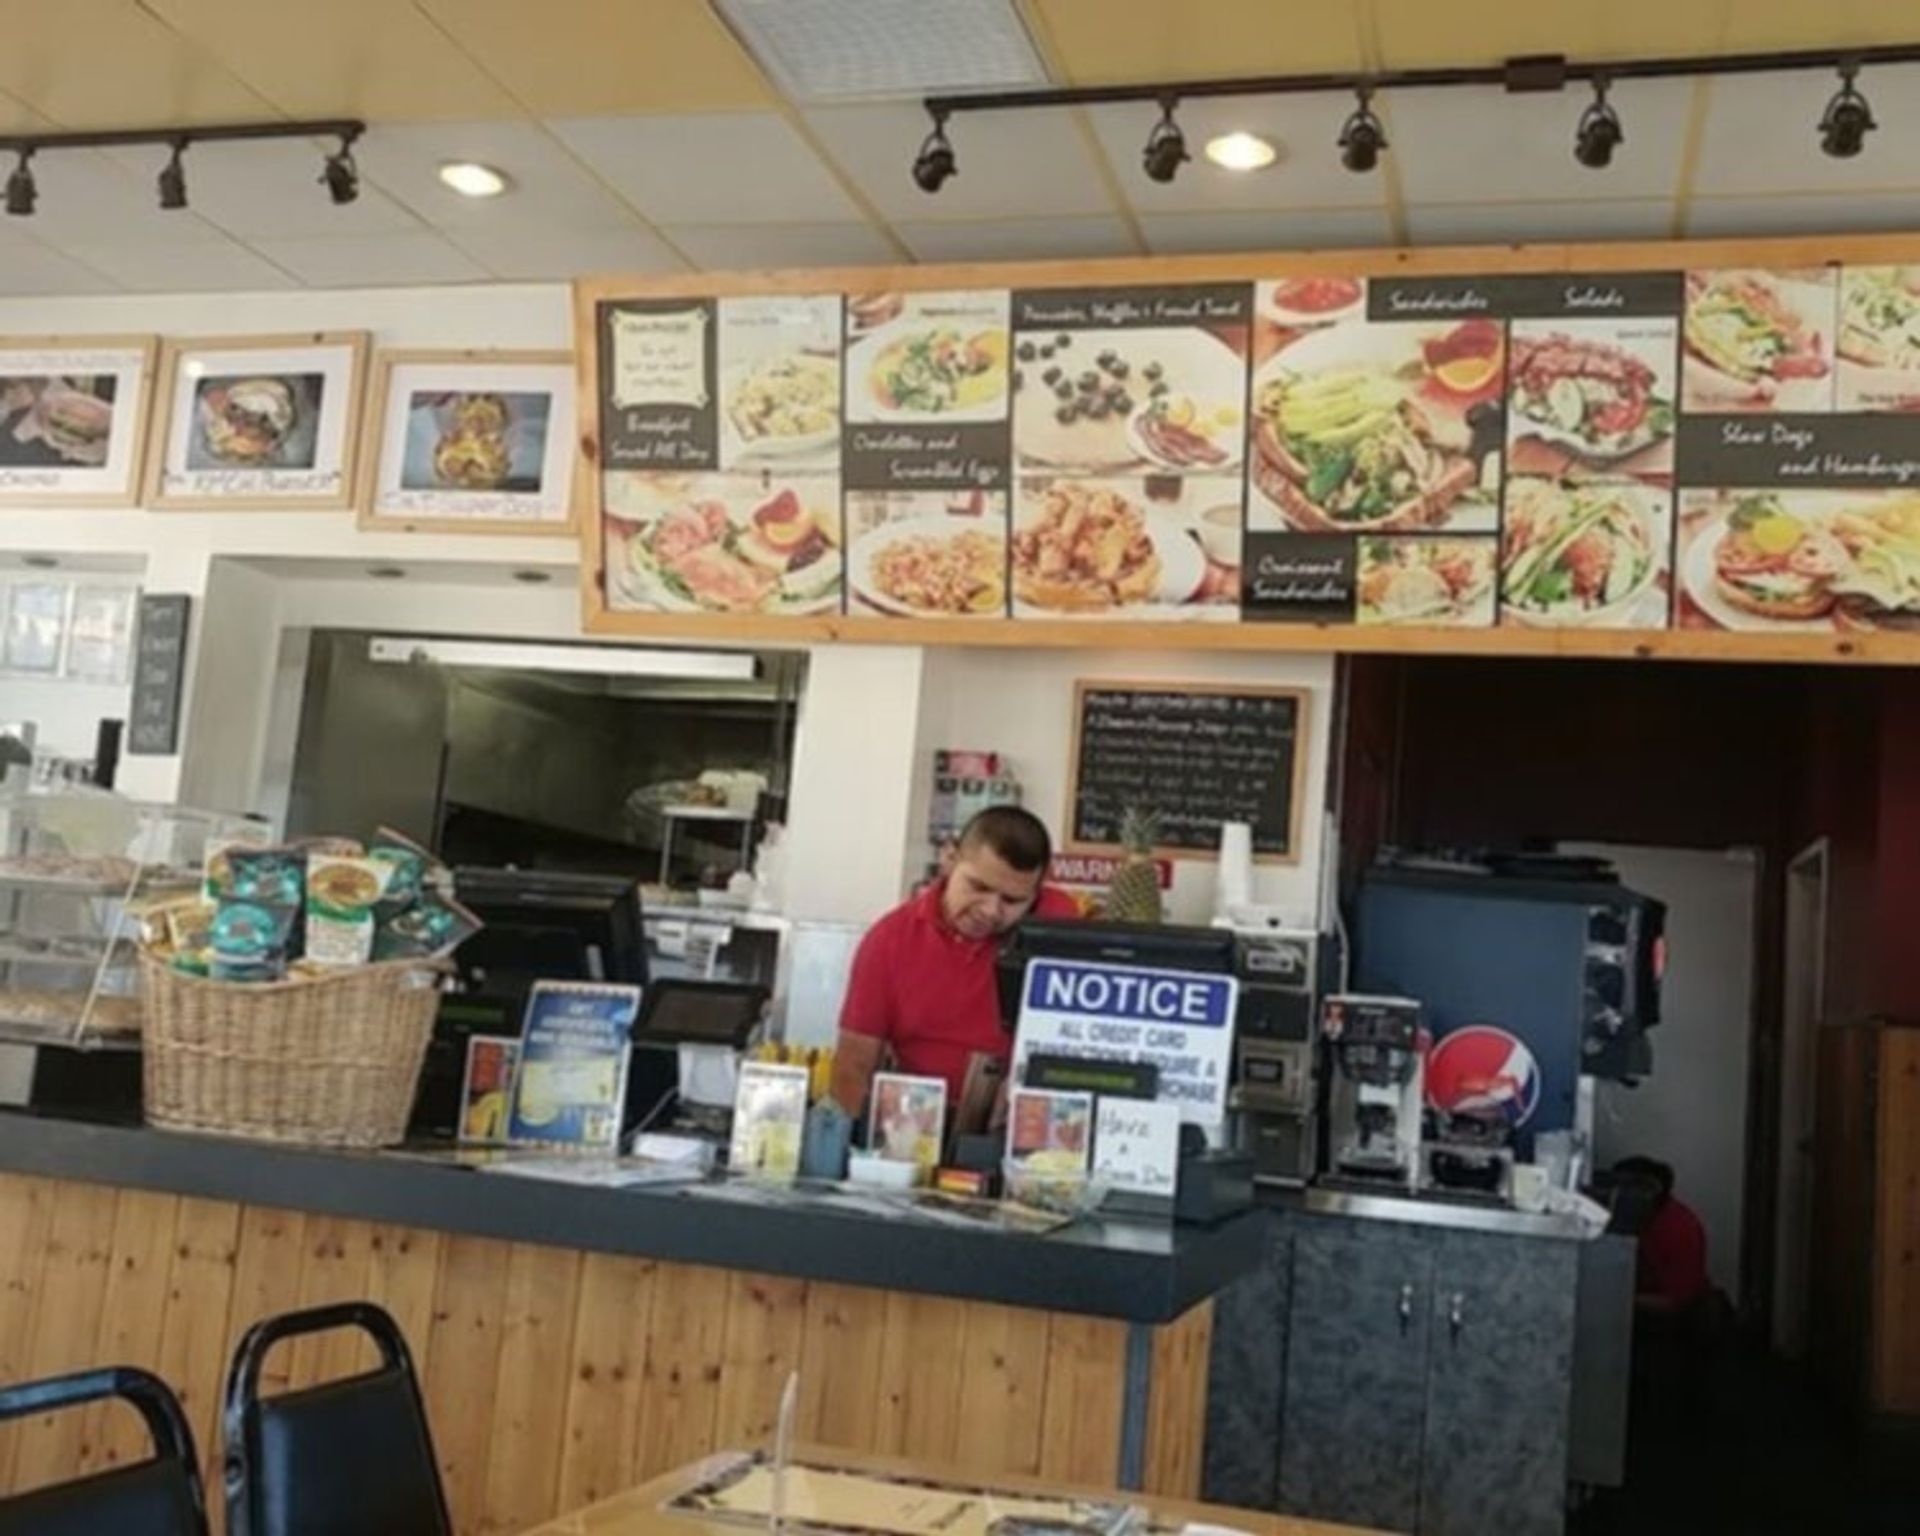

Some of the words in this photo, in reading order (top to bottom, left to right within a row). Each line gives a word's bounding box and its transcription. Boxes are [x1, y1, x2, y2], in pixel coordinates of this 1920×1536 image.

[1389, 291, 1488, 311] Sandwiches
[1563, 286, 1624, 308] Salads
[926, 432, 960, 449] and
[1771, 422, 1814, 451] Dogs
[1779, 454, 1818, 475] and
[1252, 579, 1348, 599] Sandwiches
[1045, 970, 1210, 1021] NOTICE
[1058, 1022, 1083, 1039] ALL
[1088, 1025, 1141, 1045] CREDIT
[1145, 1030, 1187, 1049] CARD
[1205, 1060, 1217, 1076] A
